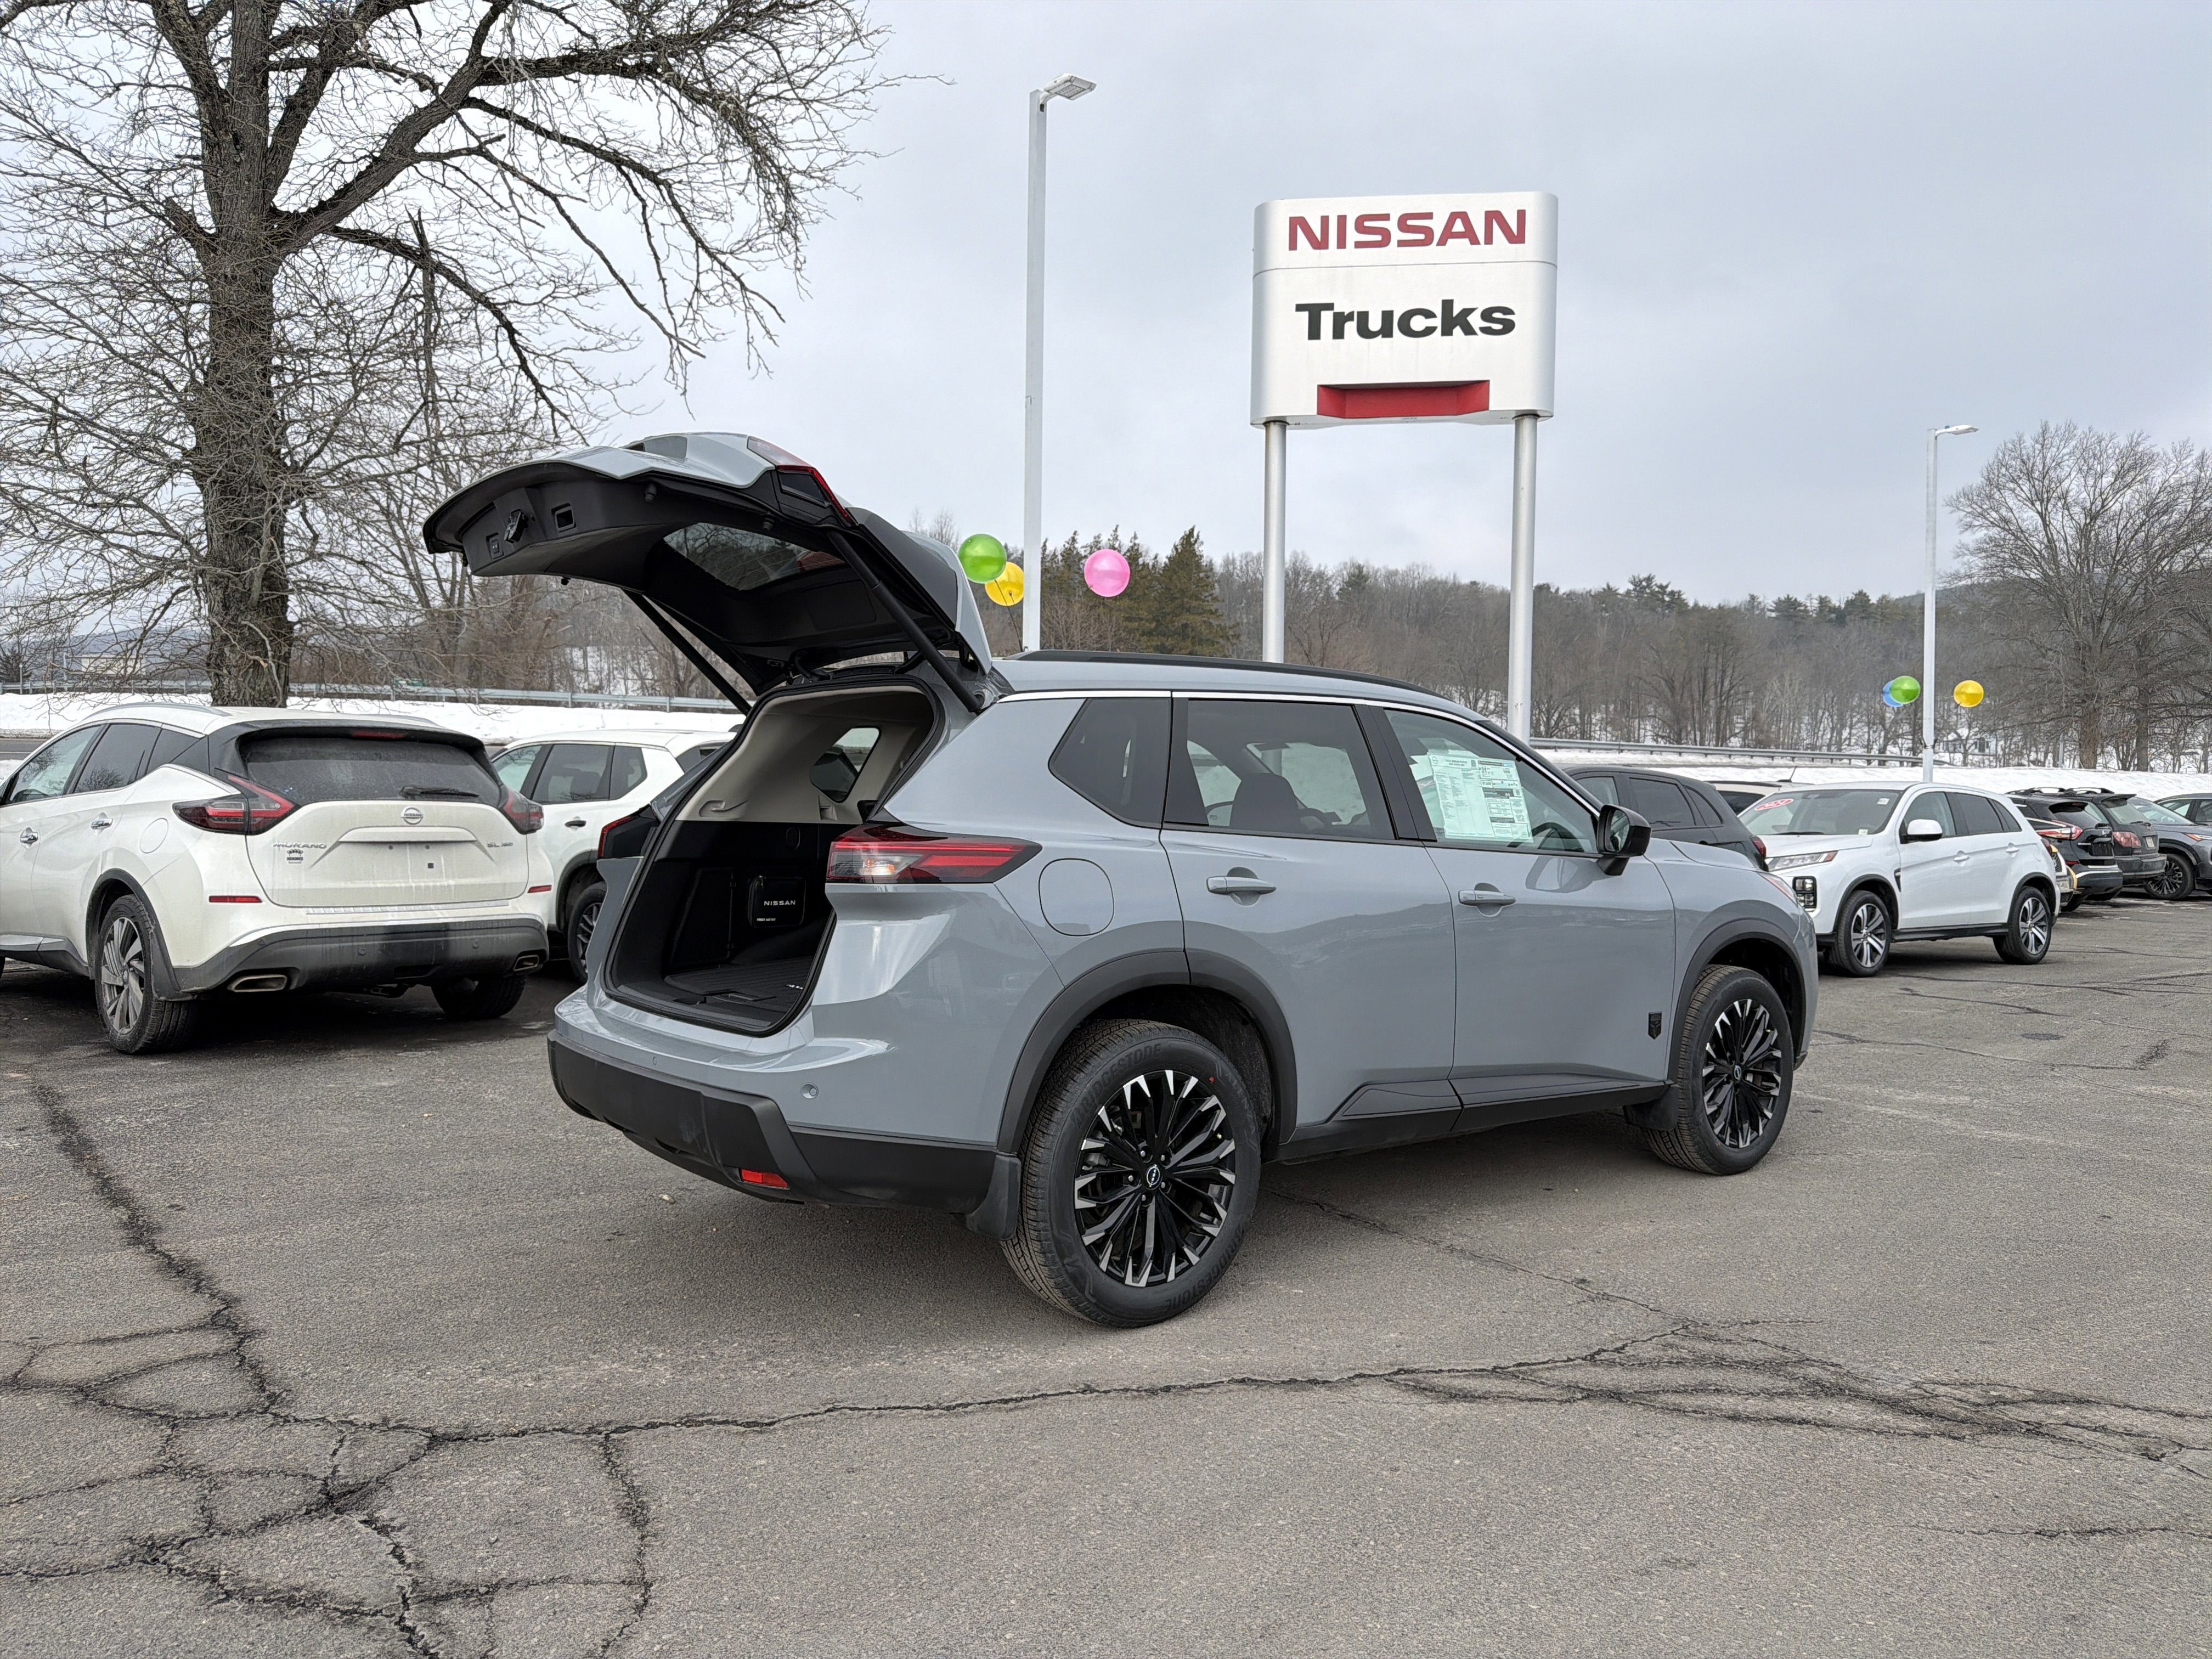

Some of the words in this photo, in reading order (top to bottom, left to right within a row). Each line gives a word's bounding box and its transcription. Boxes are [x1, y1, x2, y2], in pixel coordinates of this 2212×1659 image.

[1288, 209, 1526, 251] NISSAN
[1295, 299, 1516, 341] Trucks
[1071, 1043, 1161, 1129] BRIDGESTONE
